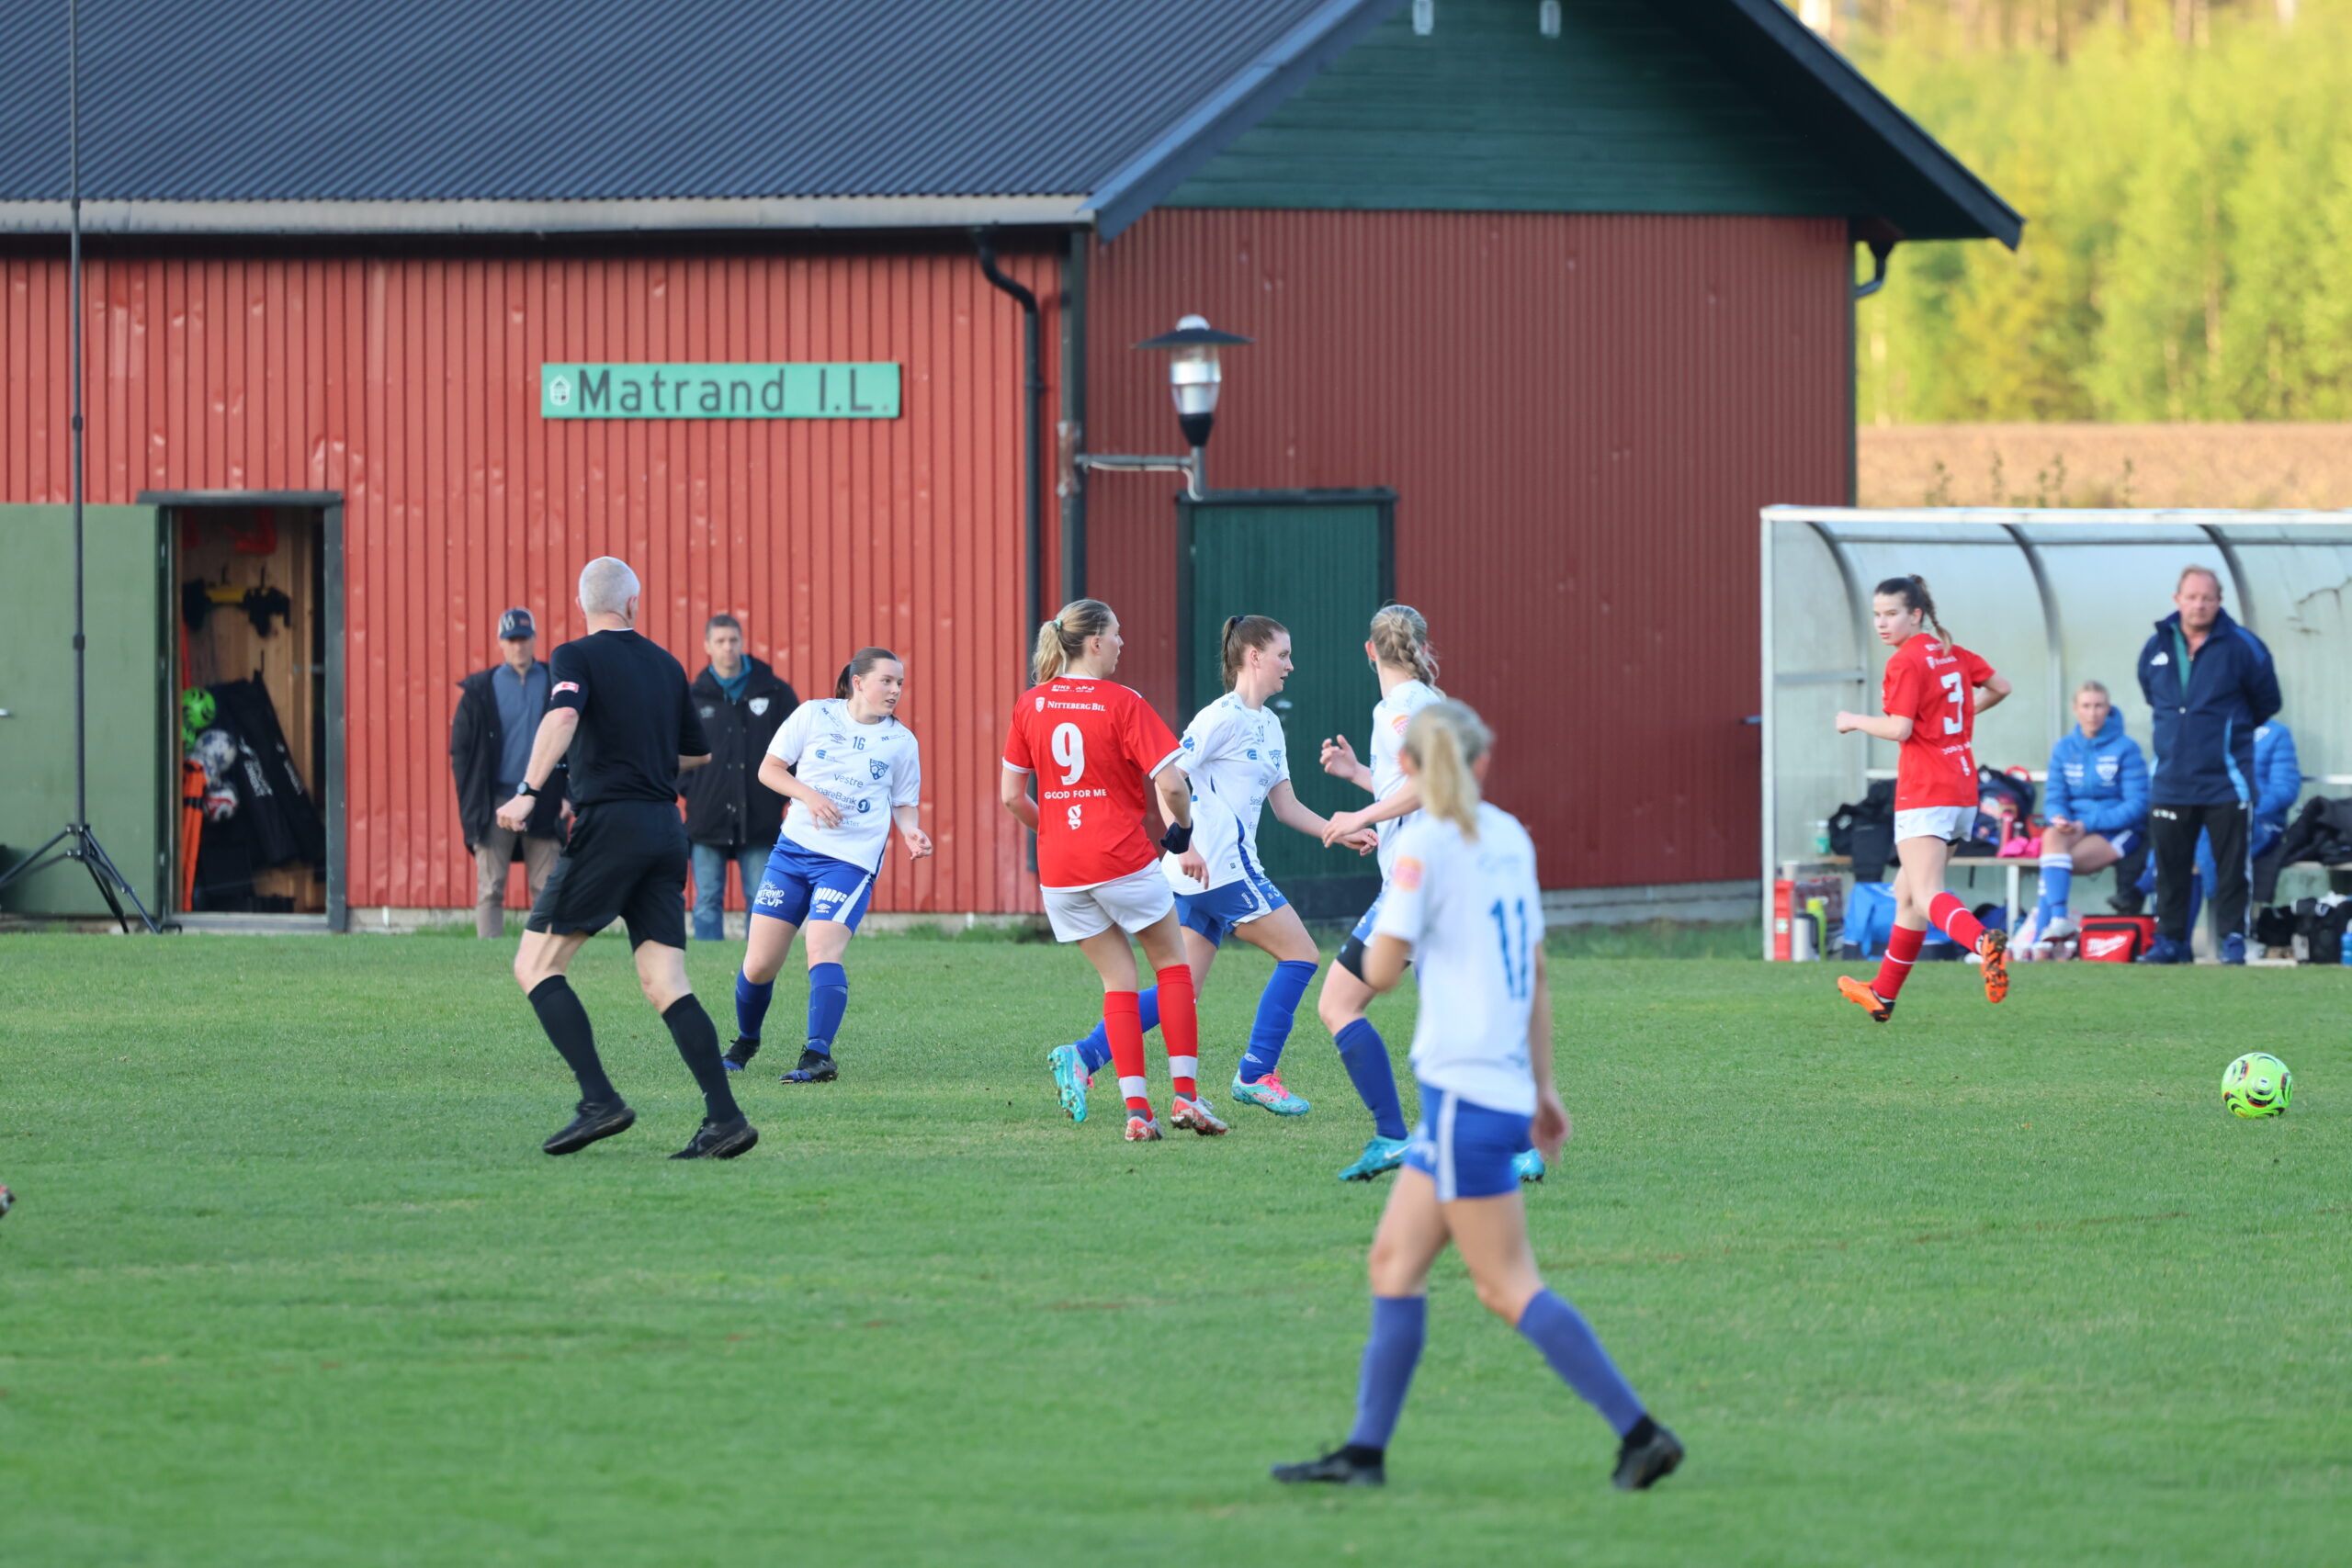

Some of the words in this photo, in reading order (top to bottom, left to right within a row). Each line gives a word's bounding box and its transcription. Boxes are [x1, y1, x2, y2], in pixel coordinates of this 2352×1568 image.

[578, 368, 786, 412] Matrand
[818, 368, 891, 412] I.L.
[1091, 702, 1106, 712] BIL
[1940, 671, 1964, 735] 3
[853, 736, 865, 750] 16
[1051, 722, 1085, 785] 9
[834, 773, 864, 788] vestre
[813, 784, 857, 806] SpareBank
[1044, 790, 1070, 799] GOOD
[1073, 789, 1091, 798] FOR
[1093, 788, 1107, 796] ME
[1489, 897, 1529, 1000] 11
